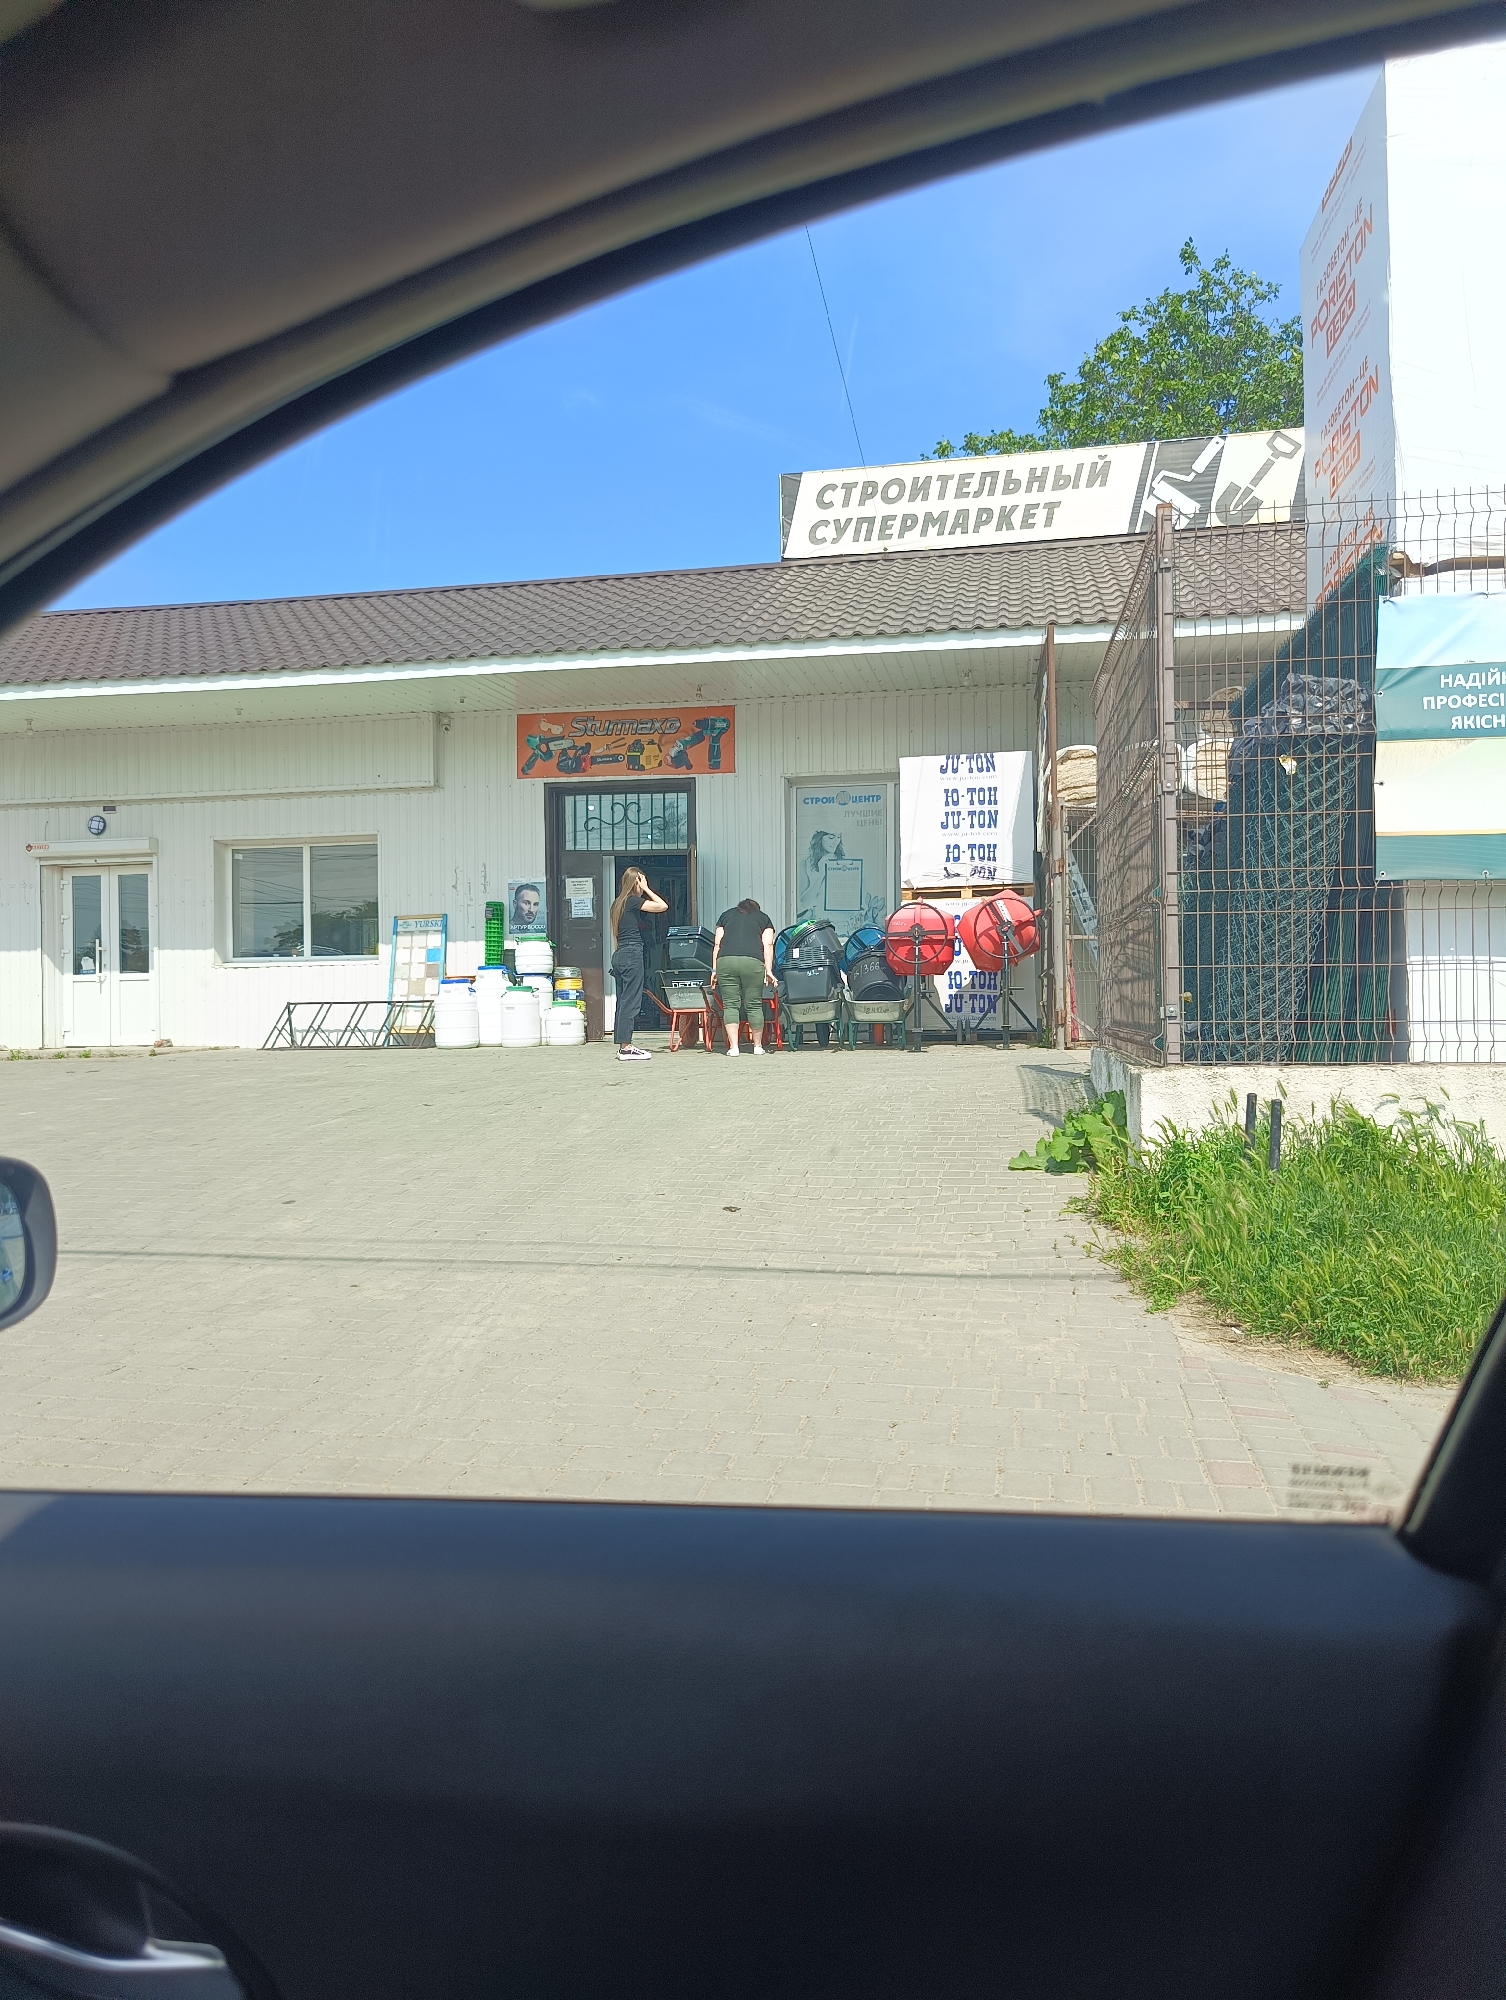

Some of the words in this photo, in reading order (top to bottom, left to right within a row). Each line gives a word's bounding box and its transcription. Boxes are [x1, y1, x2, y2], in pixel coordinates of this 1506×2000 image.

[1310, 202, 1373, 350] PORISTON
[1314, 364, 1379, 489] PORISTON
[815, 454, 1112, 511] СТРОИТЕЛЬНЫЙ
[808, 500, 1062, 546] СУПЕРМАРКЕТ
[940, 809, 998, 829] JU-TON
[944, 786, 998, 807] Ю-ТОН
[947, 970, 998, 990] Ю-ТОН
